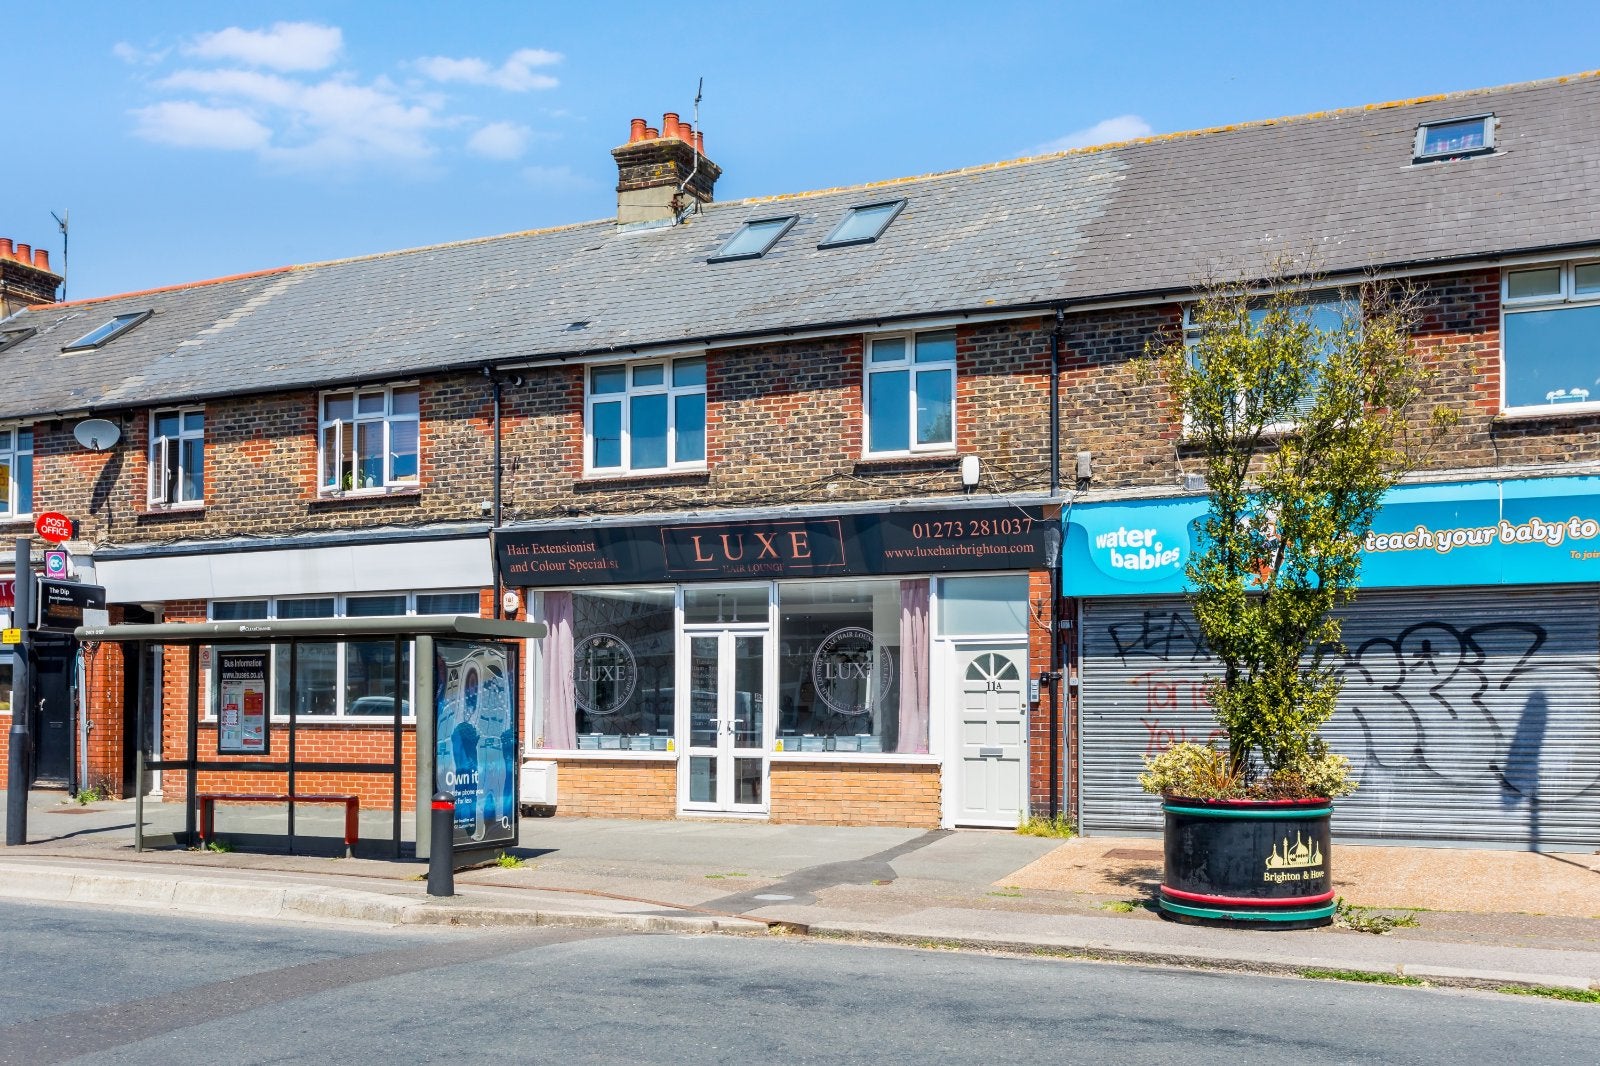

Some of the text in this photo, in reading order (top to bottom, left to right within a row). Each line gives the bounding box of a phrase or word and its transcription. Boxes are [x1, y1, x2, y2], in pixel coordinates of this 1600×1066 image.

[46, 518, 66, 528] POST
[912, 518, 1032, 539] 01273 281037
[41, 526, 68, 536] OFFICE
[1096, 526, 1157, 550] water
[1364, 526, 1434, 552] teach
[1435, 527, 1496, 552] your
[1500, 518, 1564, 546] baby
[1568, 516, 1598, 538] to
[507, 541, 596, 556] Hair Extensionist
[690, 531, 811, 562] LUXE
[884, 542, 1034, 559] www.luxehairbrighton.com
[1110, 542, 1180, 570] babies
[1570, 550, 1580, 559] To
[510, 558, 619, 573] and Colour Specialist
[722, 563, 785, 573] HAIR LOUNGE
[60, 588, 70, 596] Dip
[224, 658, 262, 668] Bus Information
[222, 671, 264, 679] www.buses.co.uk
[578, 665, 626, 682] LUXE
[986, 682, 1002, 692] 11A
[445, 770, 480, 786] Own it
[1264, 870, 1324, 884] Brighton & Hove
